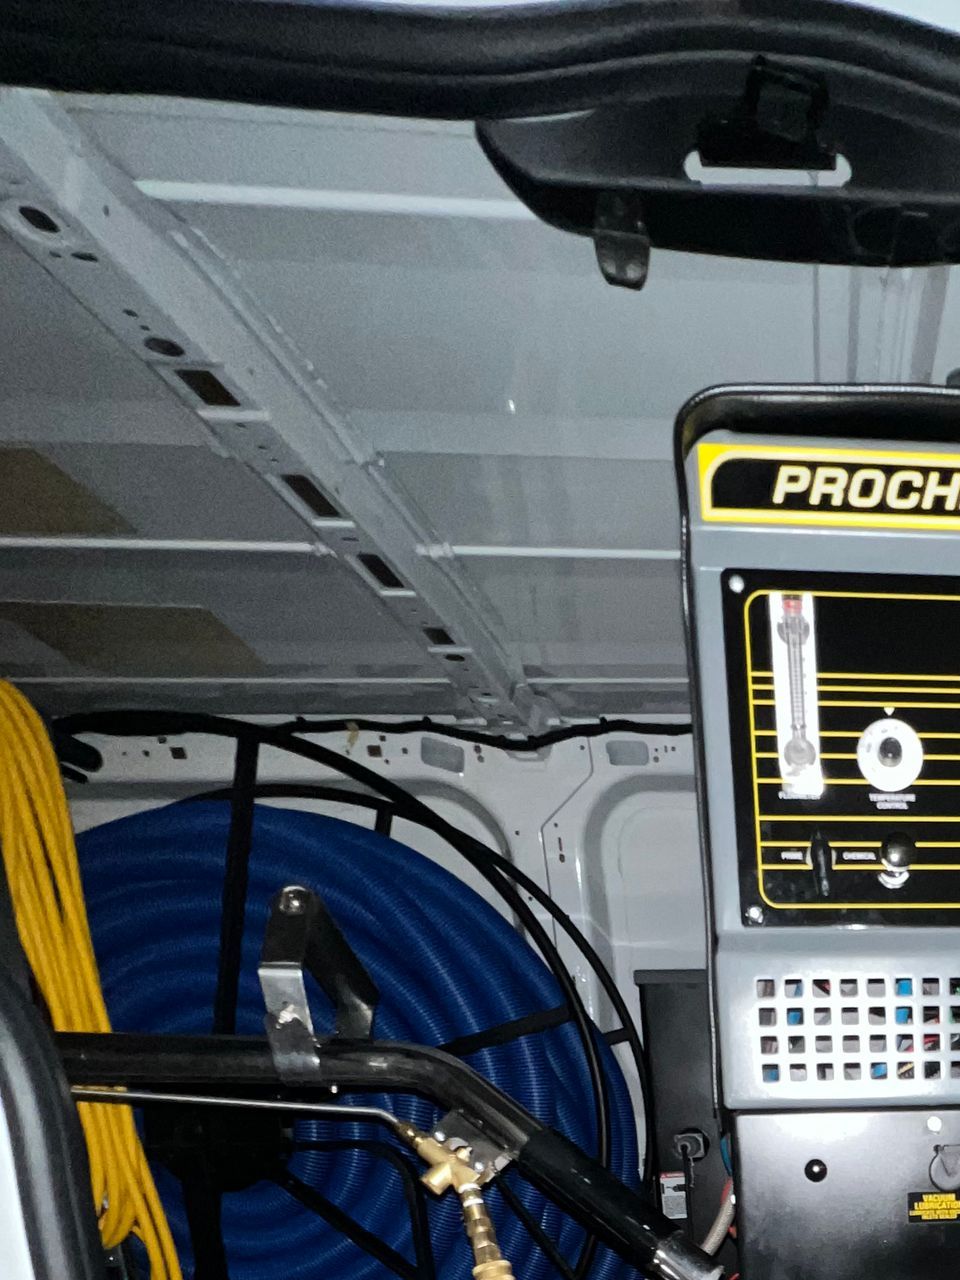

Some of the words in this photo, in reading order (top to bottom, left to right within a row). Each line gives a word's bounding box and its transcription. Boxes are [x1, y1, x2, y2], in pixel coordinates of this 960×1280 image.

[869, 792, 916, 802] TEMPERATURE
[876, 801, 909, 810] CONTROL
[842, 851, 877, 861] CHEMICAL
[922, 1193, 956, 1201] VACUUM
